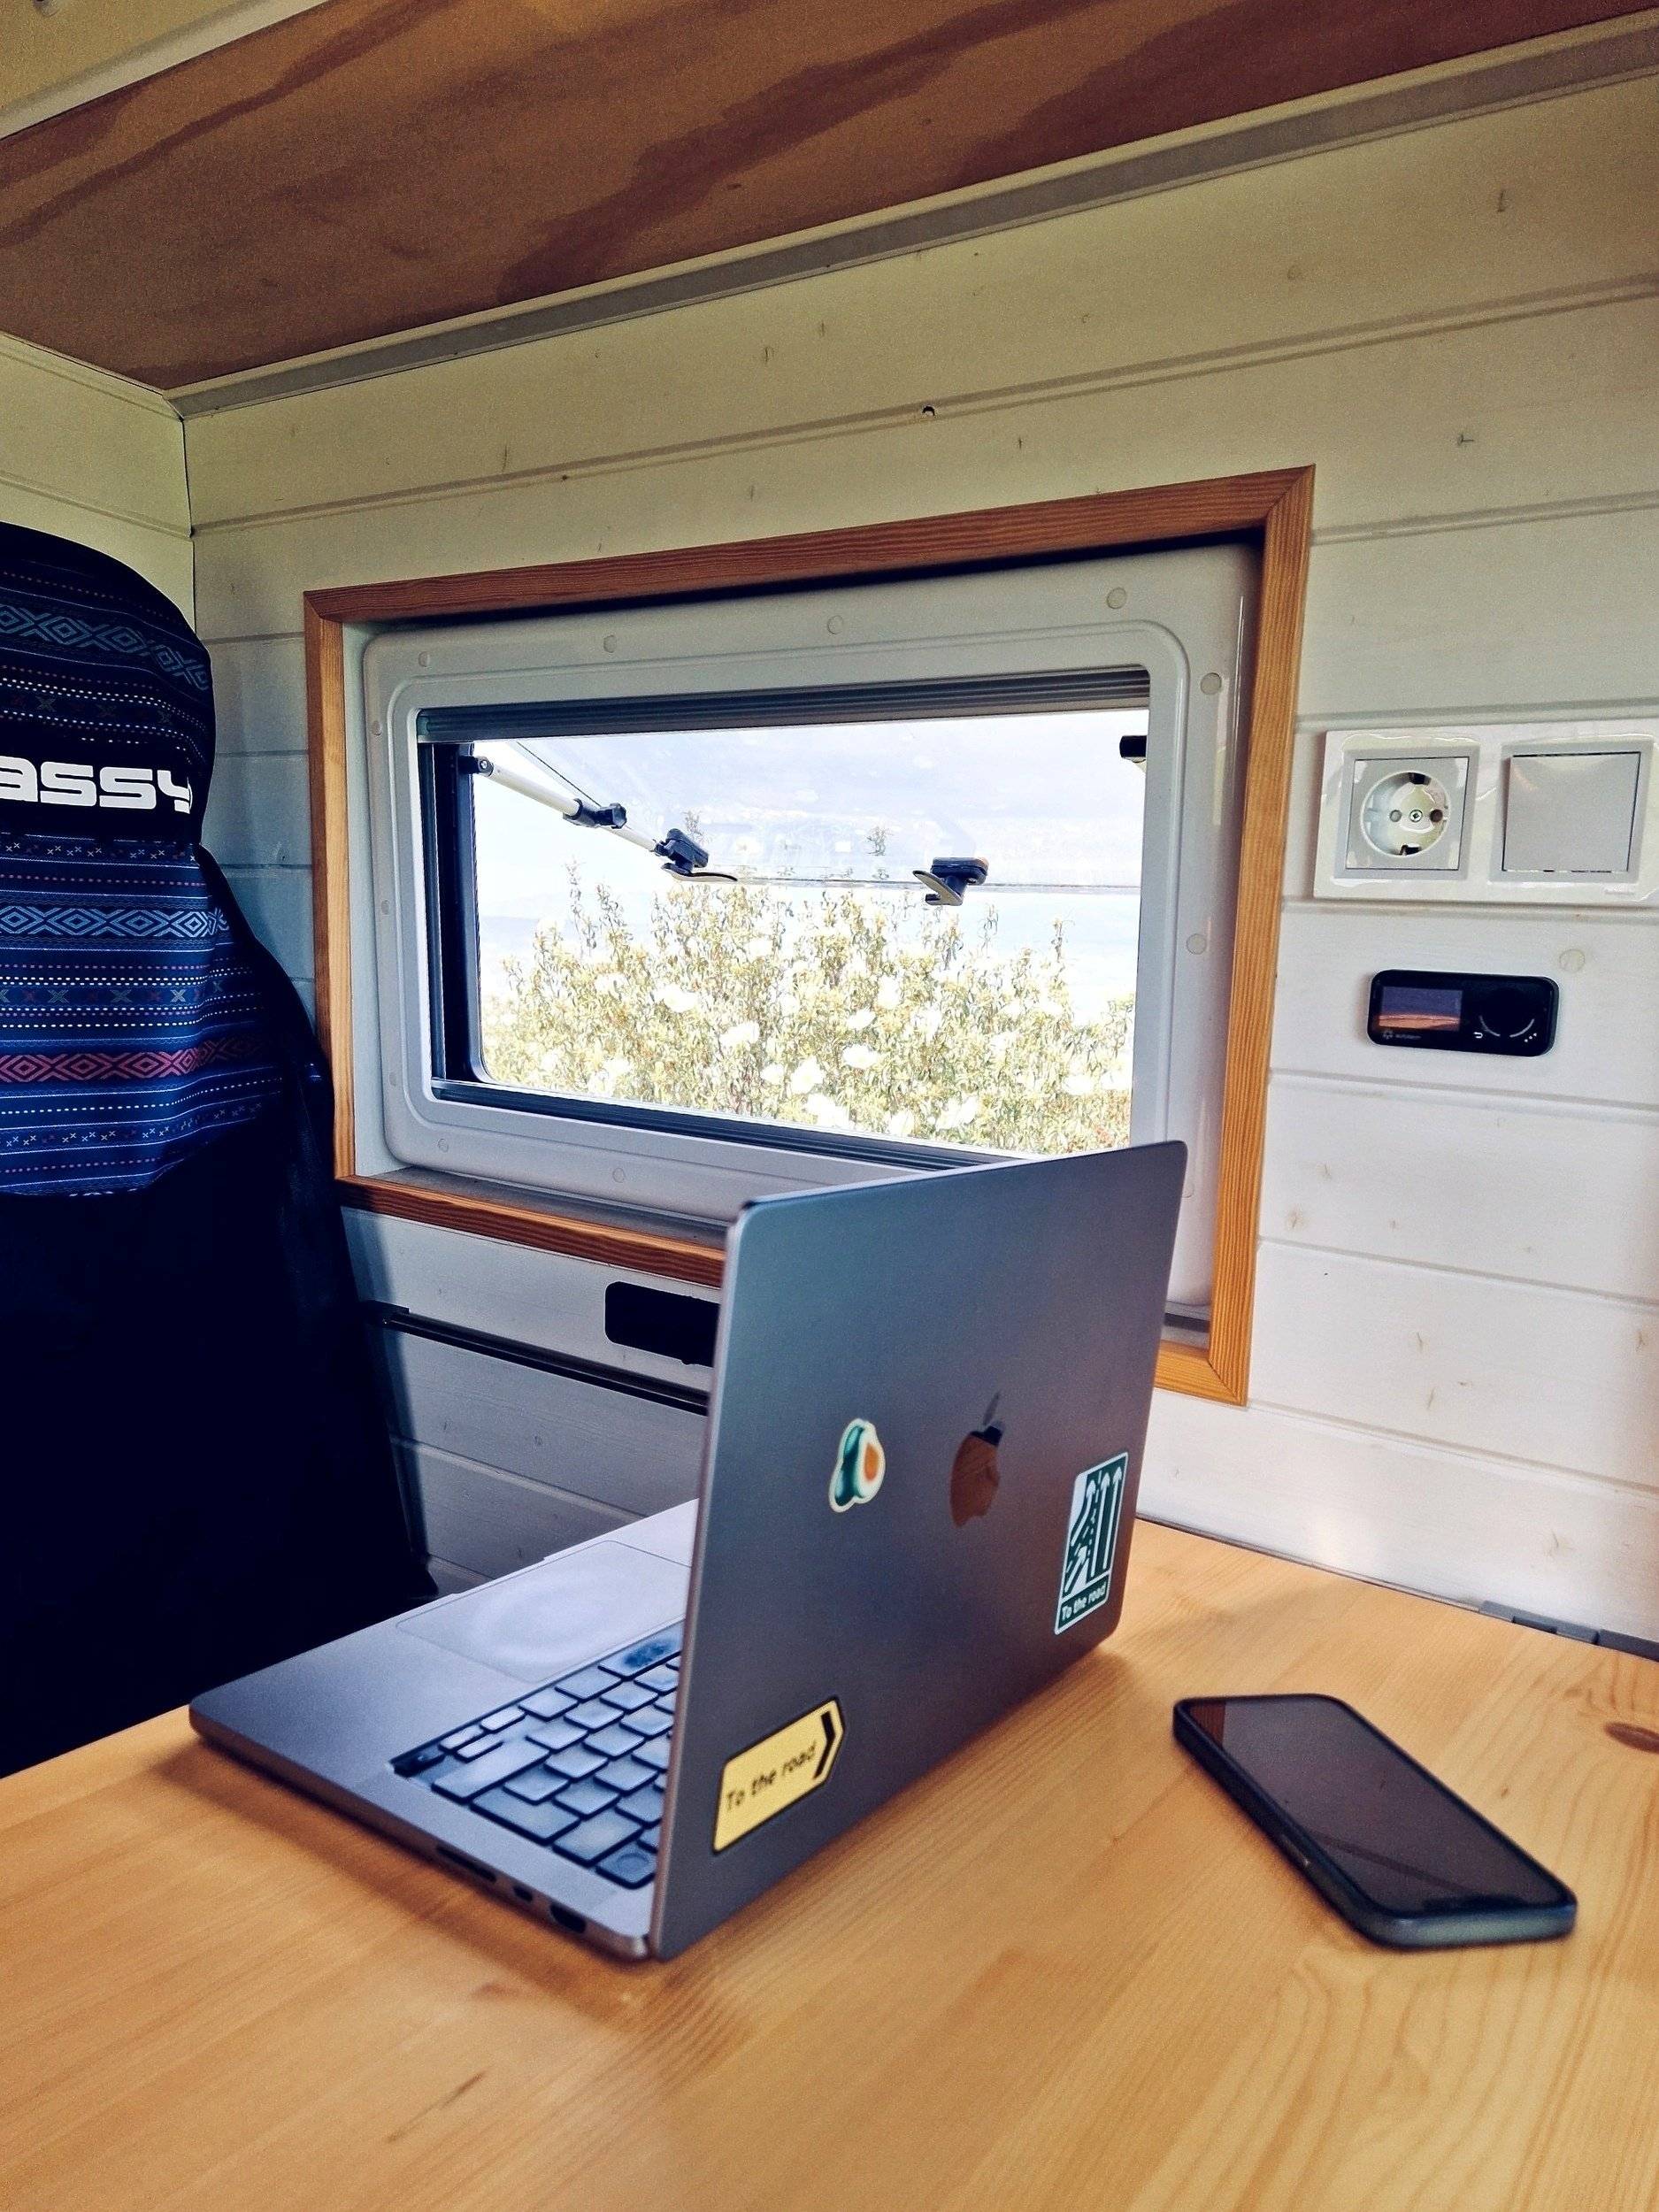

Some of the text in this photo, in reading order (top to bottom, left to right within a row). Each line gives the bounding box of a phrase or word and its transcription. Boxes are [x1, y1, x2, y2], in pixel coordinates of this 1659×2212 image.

[1062, 1581, 1107, 1621] To the road
[726, 1740, 817, 1811] To the road
